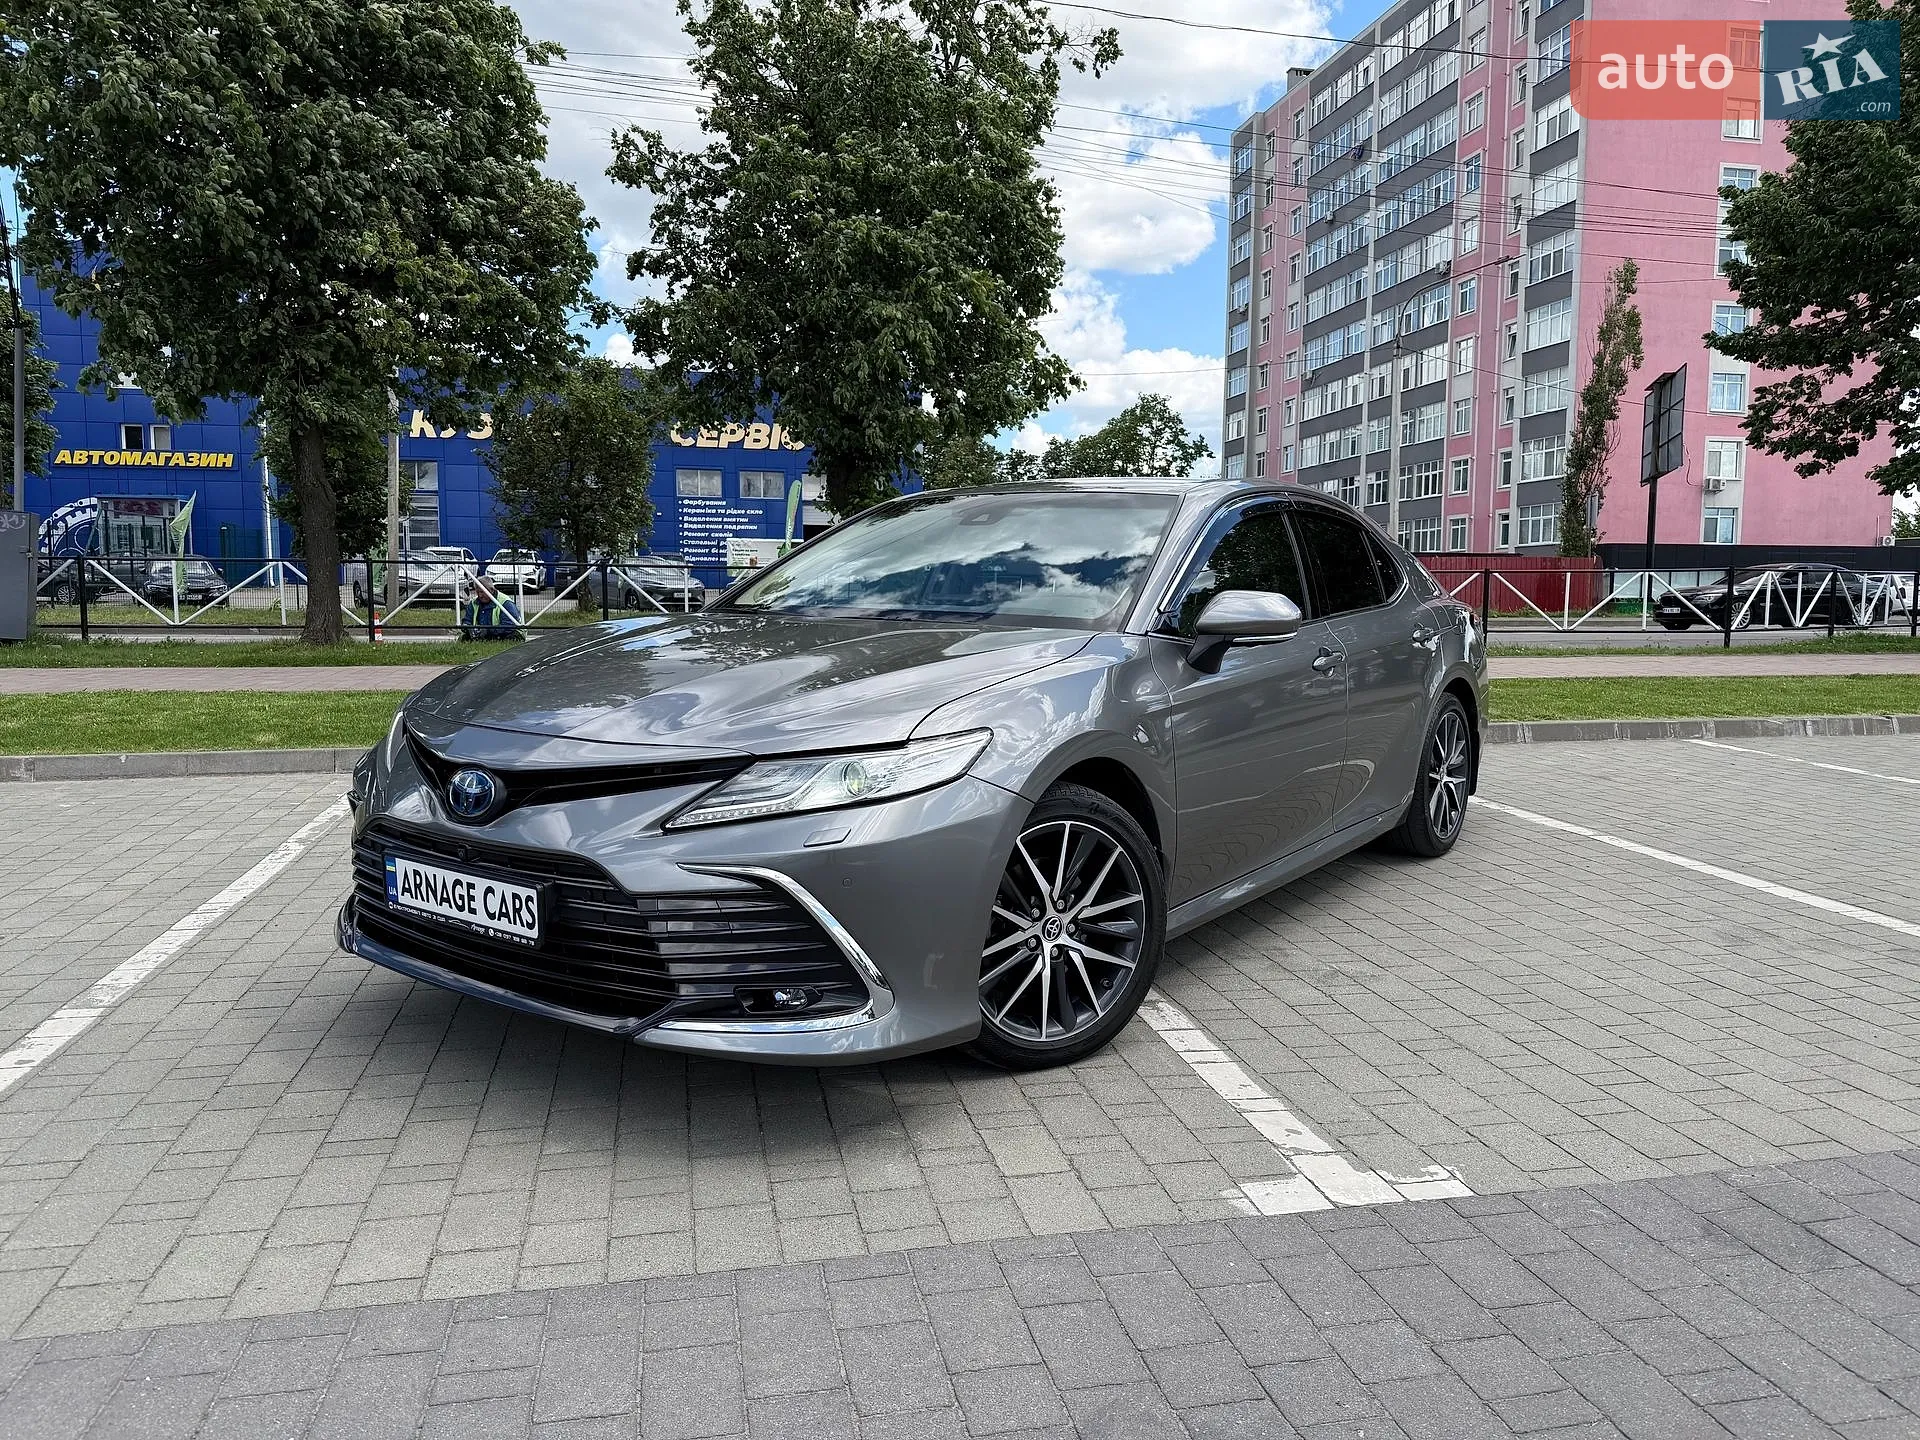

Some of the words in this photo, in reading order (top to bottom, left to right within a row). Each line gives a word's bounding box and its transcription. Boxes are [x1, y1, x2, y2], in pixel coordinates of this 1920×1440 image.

[54, 449, 234, 469] АВТОМАГАЗИН
[682, 499, 727, 507] Фарбування
[388, 885, 398, 896] UA
[400, 866, 477, 916] ARNAGE
[483, 885, 537, 931] CARS
